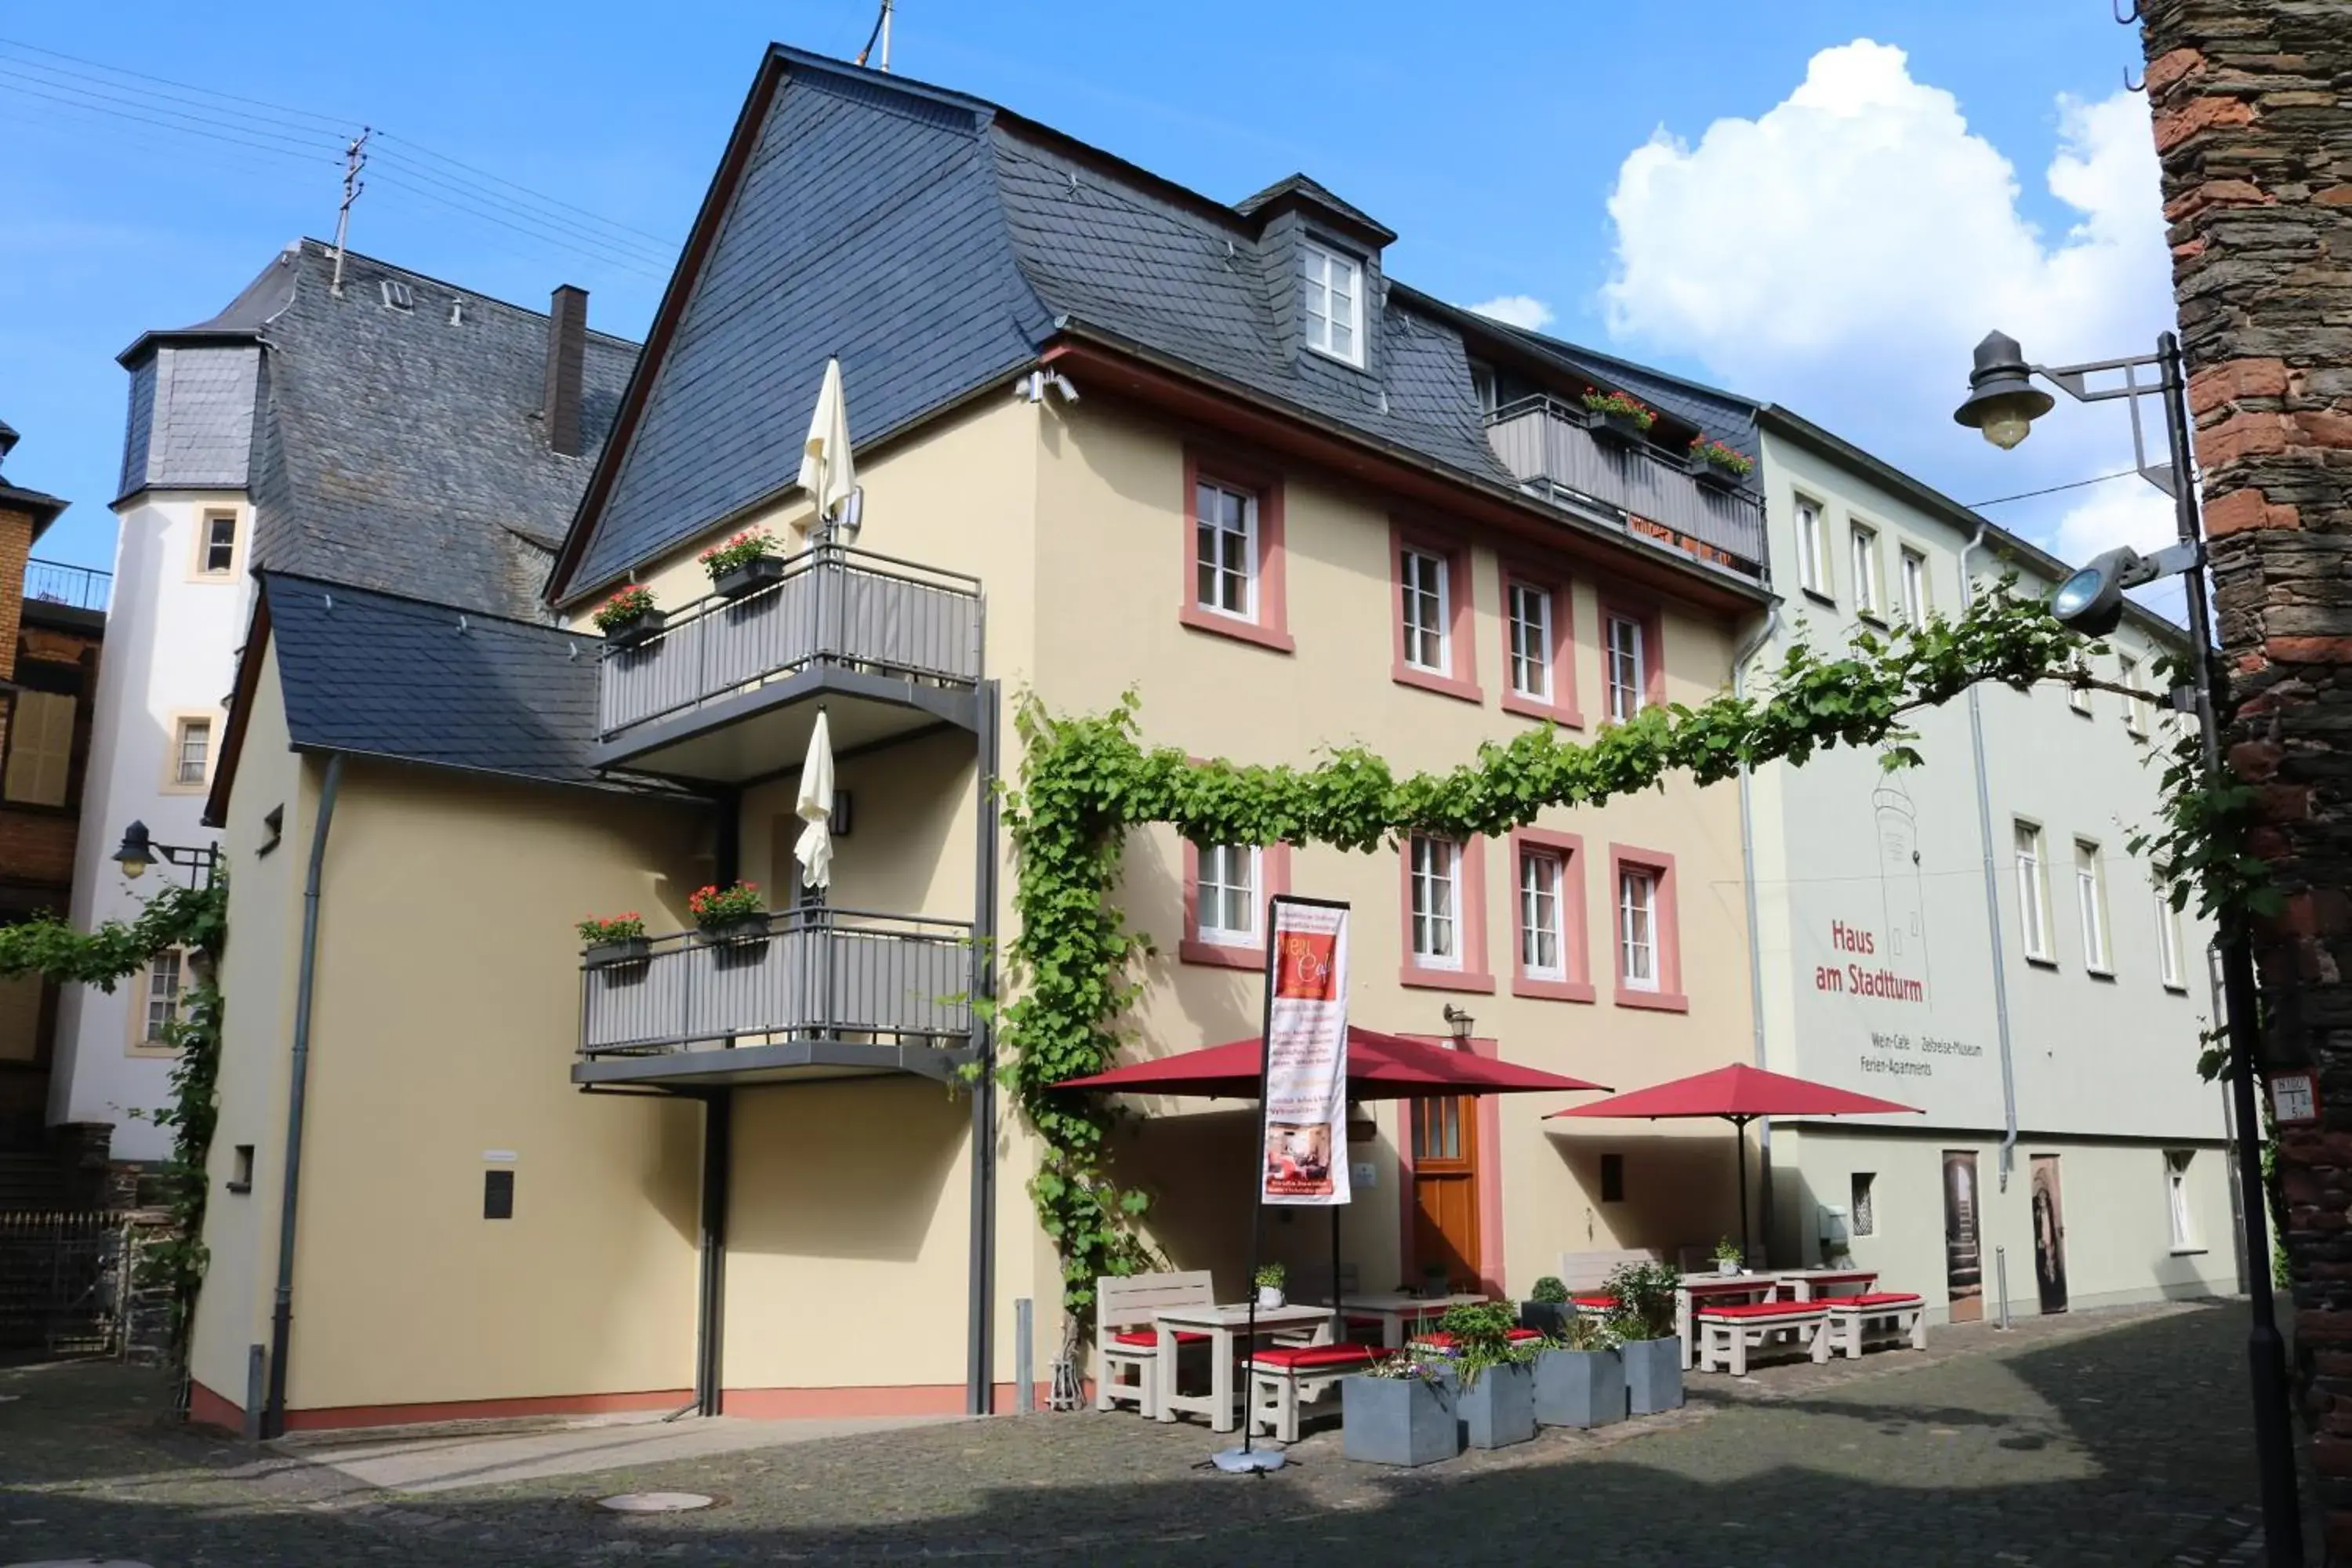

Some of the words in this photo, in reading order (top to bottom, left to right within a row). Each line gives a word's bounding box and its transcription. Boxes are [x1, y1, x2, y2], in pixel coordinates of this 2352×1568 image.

[1832, 920, 1874, 954] Haus
[1817, 966, 1842, 992] am
[1849, 964, 1922, 1002] Stadtturm
